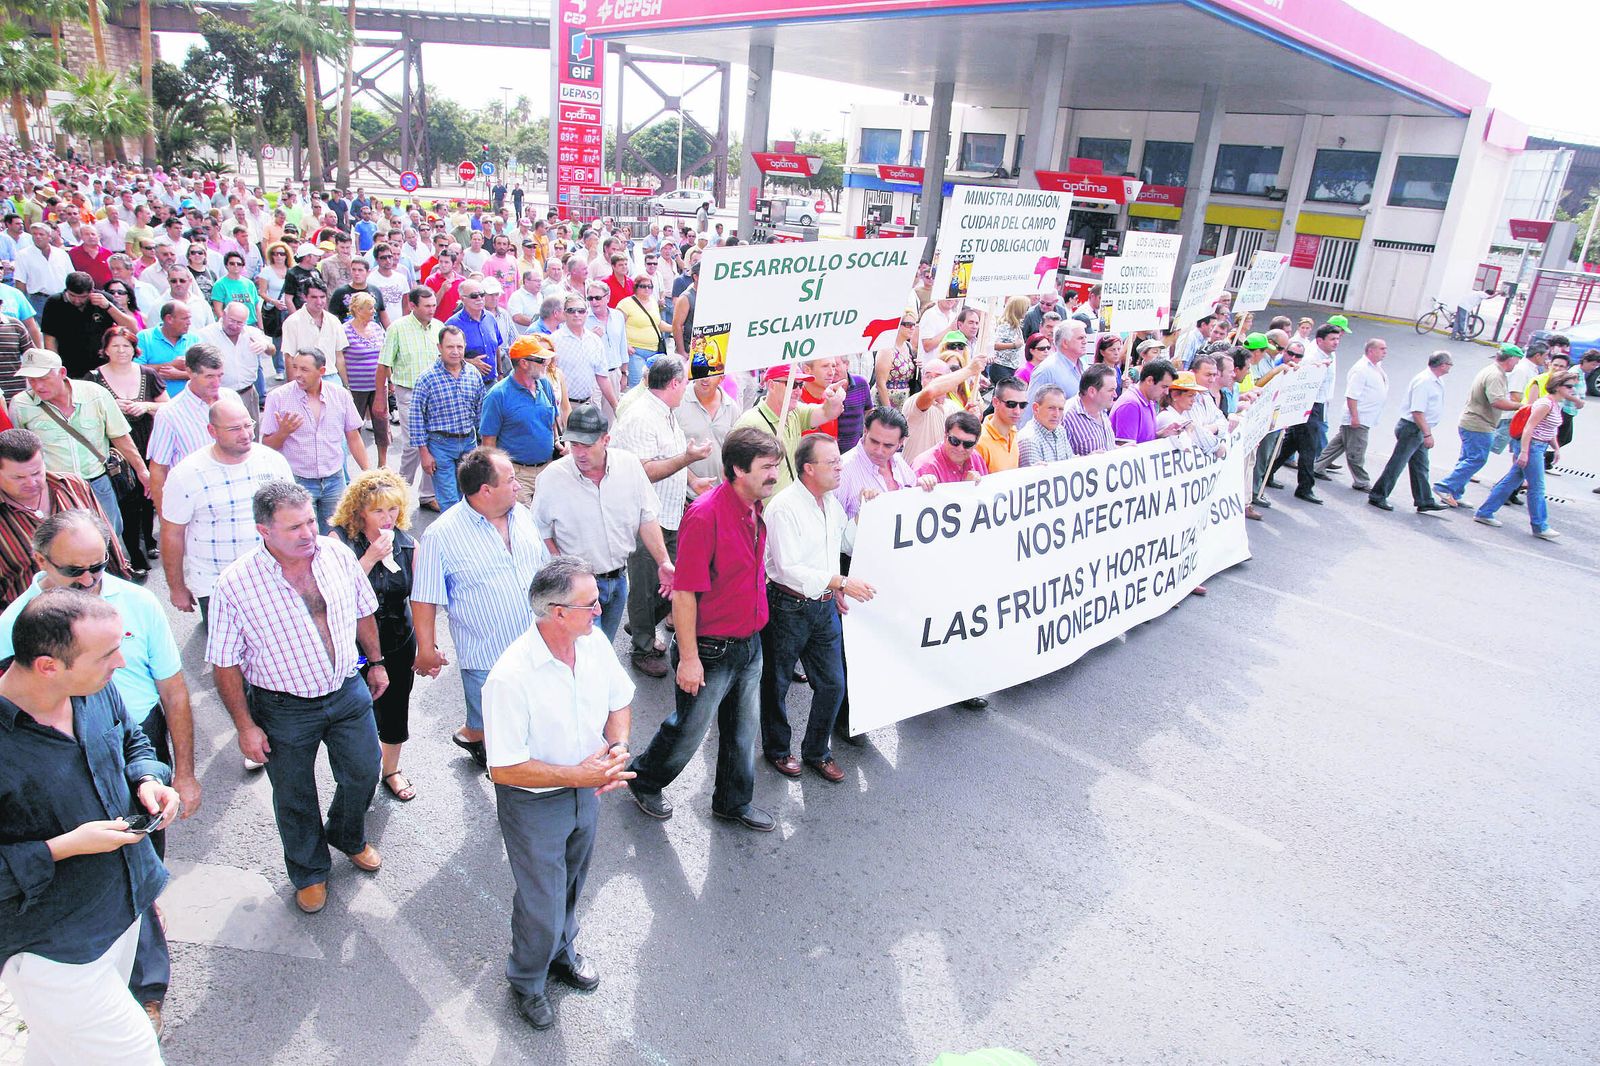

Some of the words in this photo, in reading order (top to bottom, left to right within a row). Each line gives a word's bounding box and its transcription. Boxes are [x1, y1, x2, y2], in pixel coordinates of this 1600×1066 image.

[563, 12, 587, 25] CEP
[572, 66, 592, 80] elf
[562, 88, 600, 101] DEPASO
[565, 109, 596, 122] optima
[770, 160, 798, 169] optima
[1062, 181, 1108, 193] optima
[964, 190, 1013, 206] MINISTRA
[1015, 192, 1061, 210] DIMISIÓN,
[960, 215, 1000, 229] CUIDAR
[1001, 216, 1019, 230] DEL
[1022, 217, 1056, 230] CAMPO
[960, 239, 972, 253] ES
[975, 239, 989, 252] TU
[990, 236, 1050, 252] OBLIGACIÓN
[714, 253, 843, 281] DESARROLLO
[846, 250, 909, 269] SOCIAL
[1120, 266, 1158, 277] CONTROLES
[799, 273, 827, 302] SÍ
[1104, 282, 1129, 294] REALES
[1130, 282, 1135, 293] Y
[1135, 282, 1169, 294] EFECTIVOS
[1118, 299, 1127, 310] EN
[1128, 299, 1154, 310] EUROPA
[747, 309, 858, 337] ESCLAVITUD
[782, 338, 815, 360] NO
[893, 503, 962, 550] LOS
[970, 468, 1098, 533] ACUERDOS
[1105, 456, 1146, 493] CON
[1017, 517, 1066, 562] NOS
[1072, 490, 1161, 544] AFECTAN
[1165, 487, 1177, 514] A
[1181, 470, 1221, 508] TODO
[921, 604, 988, 648] LAS
[997, 567, 1084, 630] FRUTAS
[1089, 558, 1101, 588] Y
[1106, 526, 1198, 582] HORTALIZA
[1211, 493, 1243, 525] SON
[1037, 590, 1120, 655] MONEDA
[1125, 577, 1148, 610] DE
